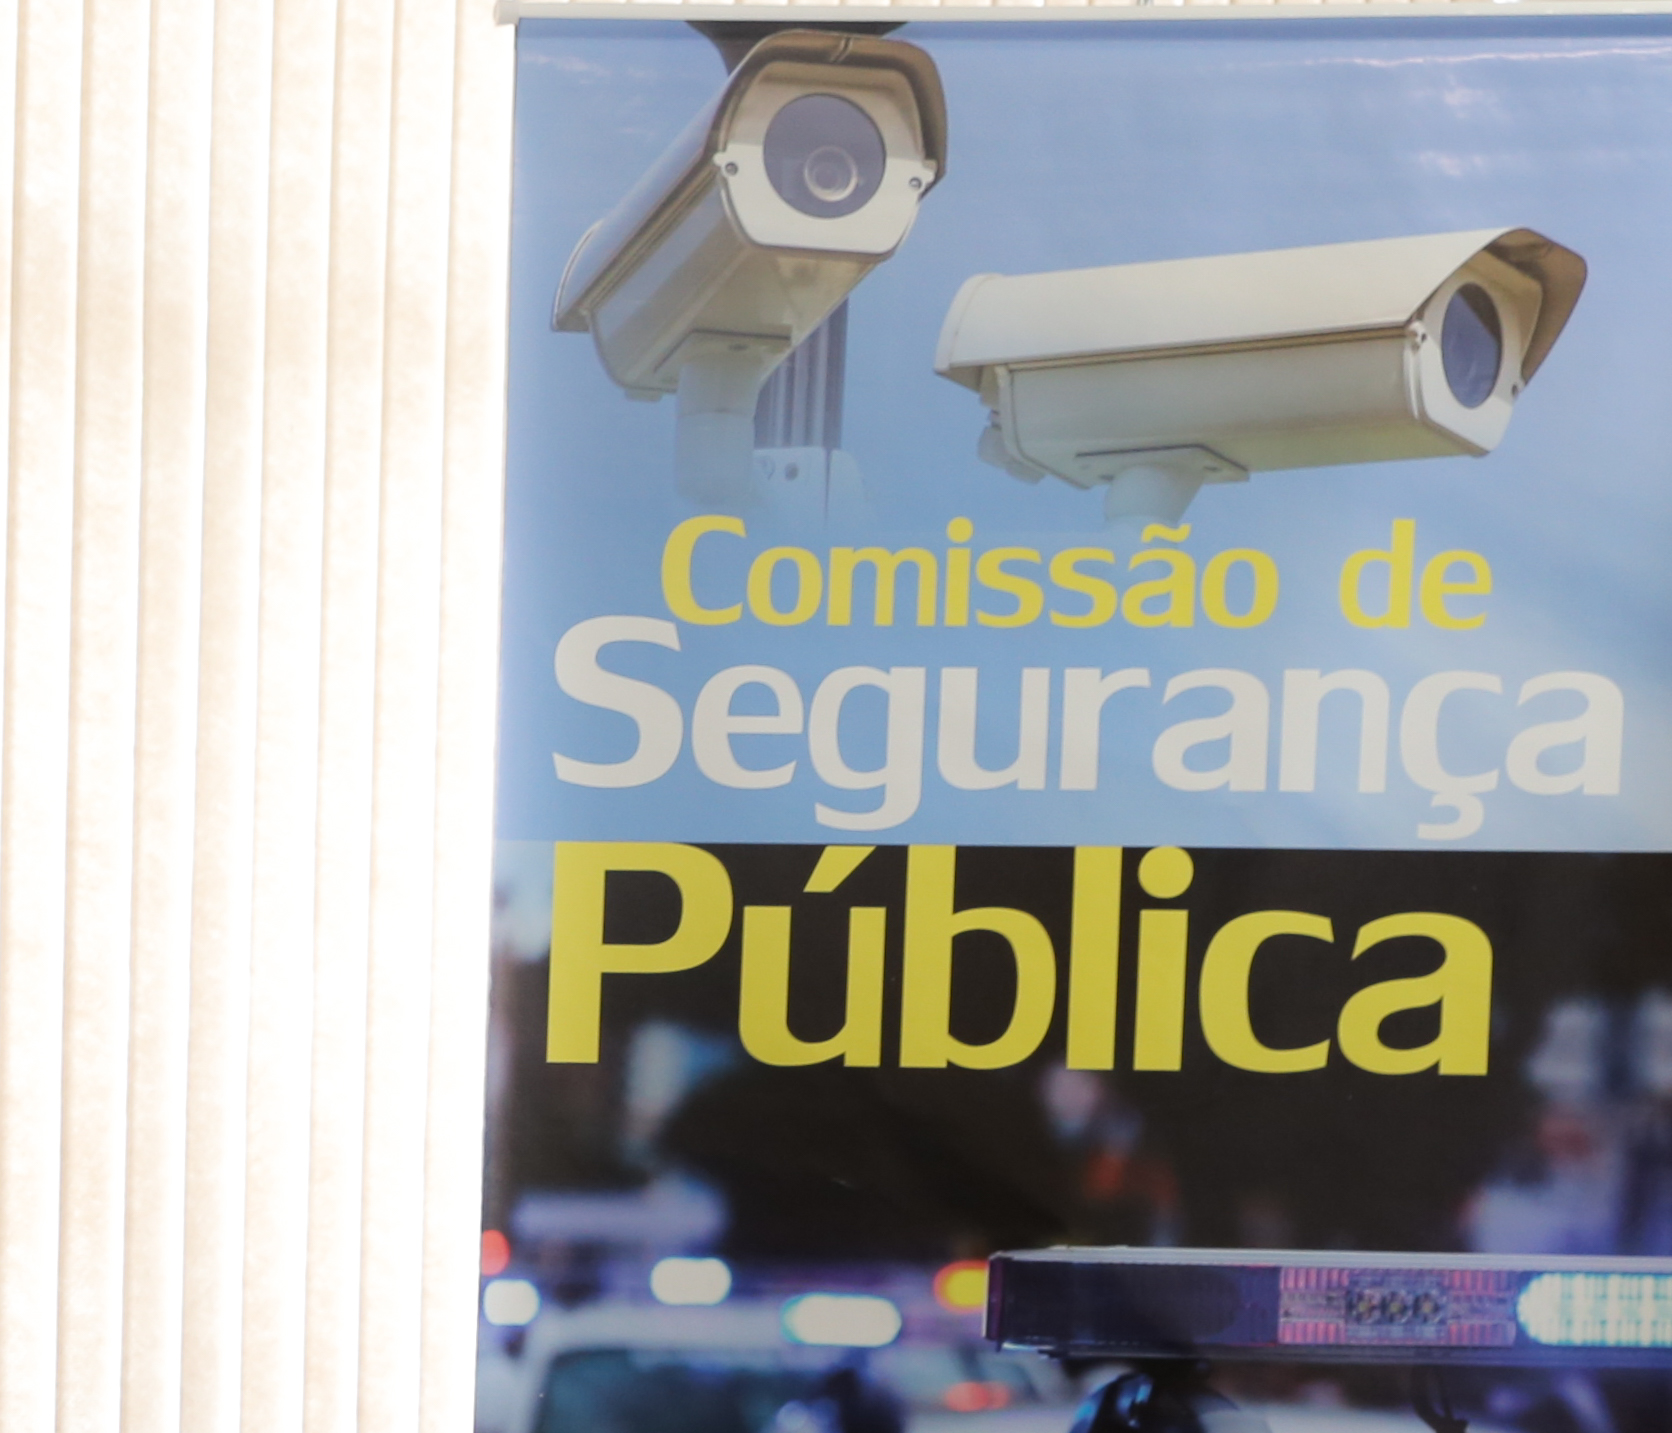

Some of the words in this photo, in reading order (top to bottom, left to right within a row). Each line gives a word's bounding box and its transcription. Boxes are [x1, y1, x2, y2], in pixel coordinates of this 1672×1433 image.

[661, 514, 1280, 630] Comissão
[1339, 518, 1493, 631] de
[552, 614, 1626, 841] Segurança
[545, 842, 1494, 1077] Pública
